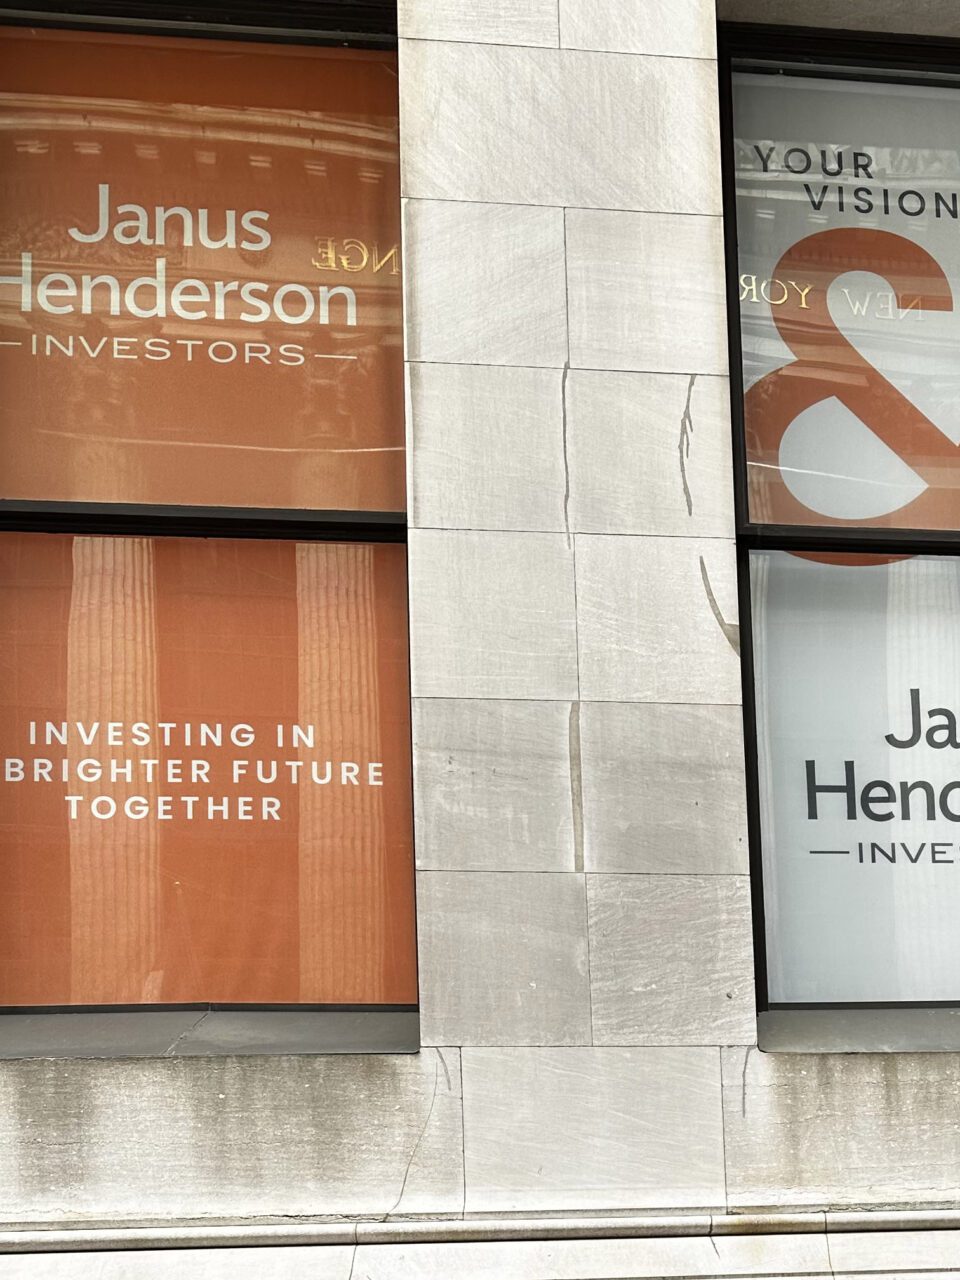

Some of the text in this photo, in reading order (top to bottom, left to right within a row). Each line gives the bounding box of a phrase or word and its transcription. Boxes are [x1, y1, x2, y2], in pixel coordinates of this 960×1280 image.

[754, 144, 873, 178] YOUR
[67, 183, 272, 251] Janus
[804, 183, 959, 219] VISION
[0, 252, 357, 326] Henderson
[31, 334, 306, 366] INVESTORS
[29, 721, 315, 748] INVESTING IN
[5, 758, 384, 786] BRIGHTER FUTURE
[64, 795, 282, 821] TOGETHER
